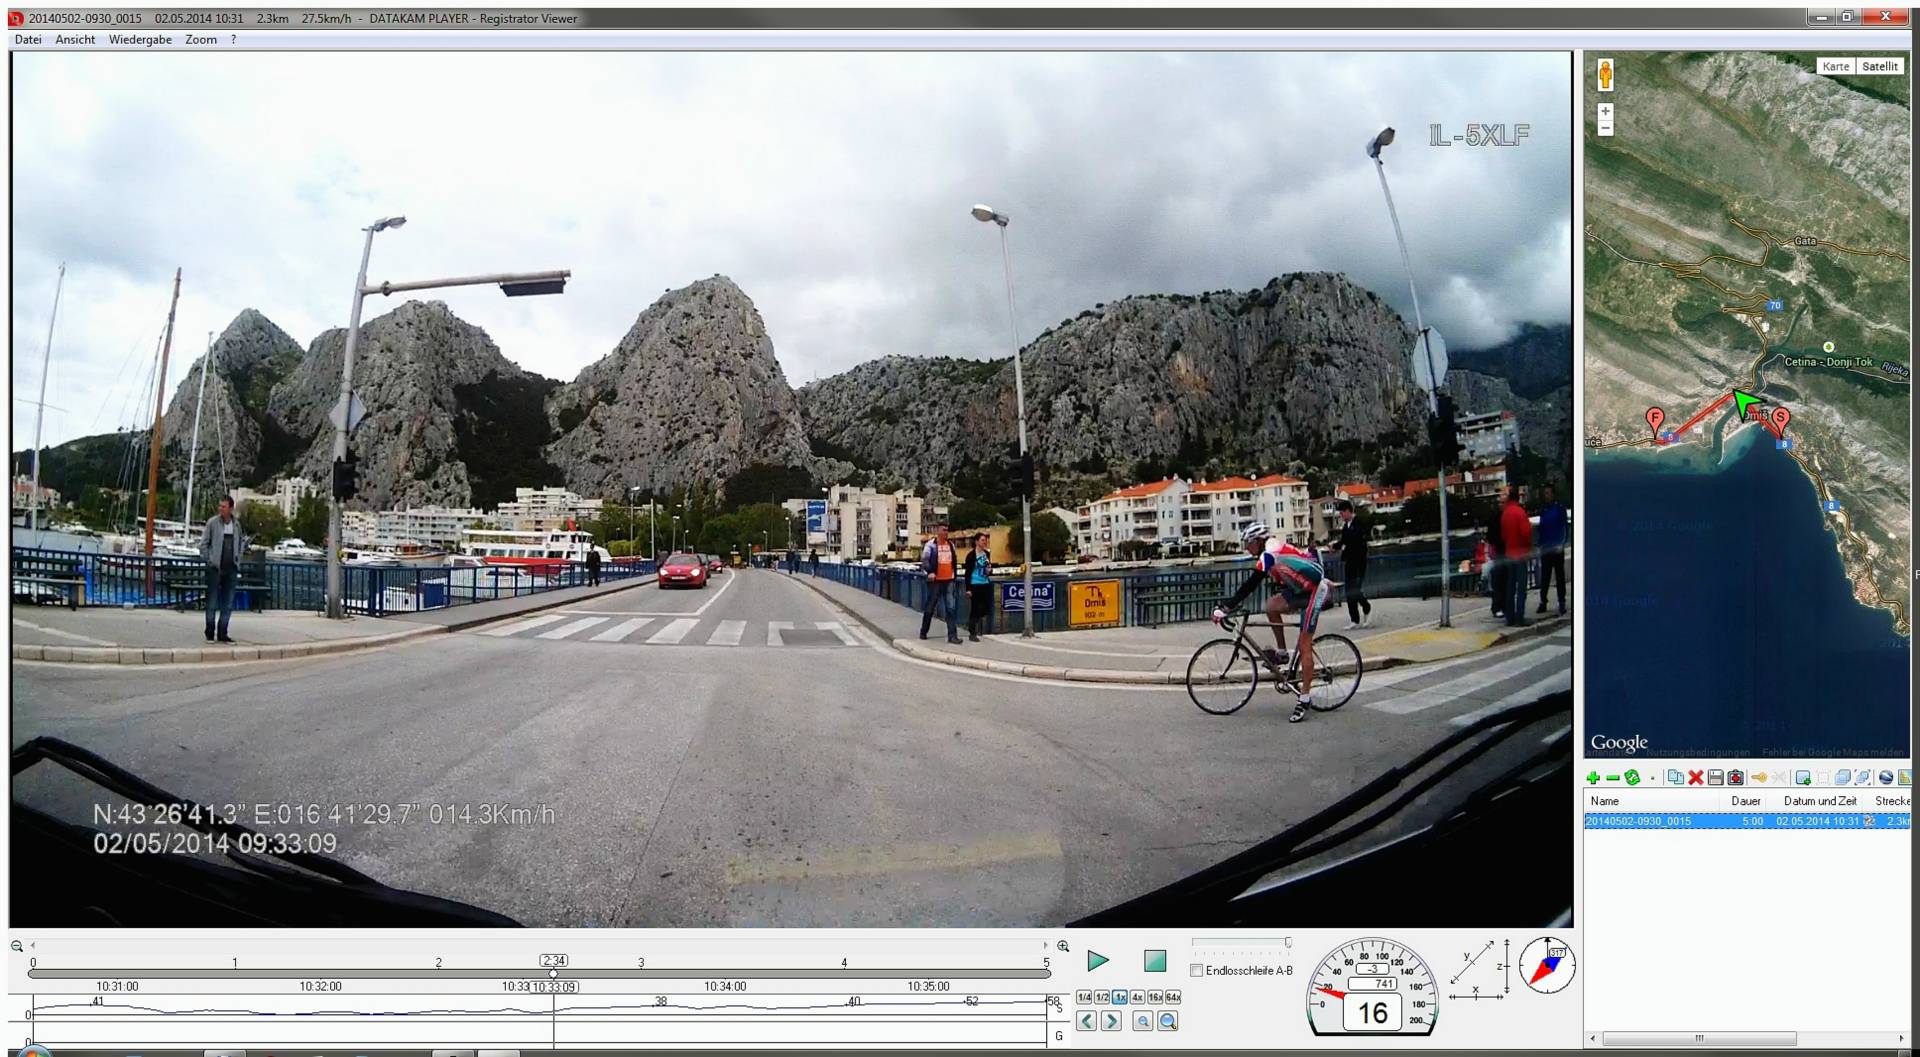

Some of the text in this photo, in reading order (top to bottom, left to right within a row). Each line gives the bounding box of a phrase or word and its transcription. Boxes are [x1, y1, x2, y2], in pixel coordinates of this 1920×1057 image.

[29, 13, 142, 26] 20140502-0930_0015
[154, 13, 213, 24] 02.05.2014
[215, 13, 244, 24] 10:31
[256, 13, 289, 24] 2.3km
[302, 13, 352, 25] 27.5km/h
[370, 13, 426, 24] DATAKAM
[428, 13, 469, 24] PLAYER
[480, 13, 539, 27] Registrator
[541, 13, 578, 24] Viewer
[15, 34, 42, 45] Datei
[55, 34, 96, 45] Ansicht
[109, 34, 172, 48] Wiedergabe
[185, 34, 218, 45] Zoom
[231, 33, 237, 45] ?
[1823, 61, 1850, 72] Karte
[1862, 61, 1898, 72] Satellit
[1794, 236, 1817, 247] Gata
[1770, 301, 1781, 310] 70
[1785, 357, 1817, 367] Cetina
[1827, 357, 1852, 368] Donji
[1855, 357, 1873, 367] Tok
[1881, 361, 1909, 377] Rijeka
[1651, 412, 1659, 422] F
[1776, 411, 1785, 422] S
[1009, 586, 1049, 597] Ceina
[1591, 733, 1648, 755] Google
[1648, 749, 1750, 758] Nutzungsbedingungen
[1763, 747, 1791, 757] Fehler
[1808, 747, 1840, 759] Google
[1842, 747, 1869, 759] Maps
[1871, 747, 1904, 757] melden
[1591, 795, 1620, 806] Name
[1731, 795, 1761, 806] Dauer
[1784, 795, 1857, 806] Datum und Zeit
[1875, 795, 1911, 806] Strecke
[1585, 816, 1692, 827] 20140502-0930_0015
[1743, 816, 1764, 826] 5:00
[1776, 816, 1859, 826] 02.05.2014 10:31
[544, 955, 565, 966] 2:34
[1206, 965, 1293, 976] Endlosschleife A-B
[1332, 968, 1342, 976] 40
[1367, 964, 1378, 974] -3
[1401, 968, 1414, 976] 140
[96, 980, 139, 992] 10:31:00
[300, 980, 342, 992] 10:32:00
[533, 982, 575, 993] 10:33:09
[704, 981, 747, 992] 10:34:00
[908, 980, 950, 992] 10:35:00
[1375, 979, 1393, 989] 741
[1409, 983, 1423, 991] 160
[1078, 992, 1092, 1002] 1/4
[1096, 992, 1109, 1002] 1/2
[1116, 992, 1126, 1002] 1x
[1132, 992, 1143, 1002] 4x
[1149, 992, 1163, 1002] 16x
[1166, 992, 1181, 1002] 64x
[1359, 1002, 1388, 1024] 16
[1409, 1016, 1423, 1024] 200
[1056, 1031, 1063, 1041] G
